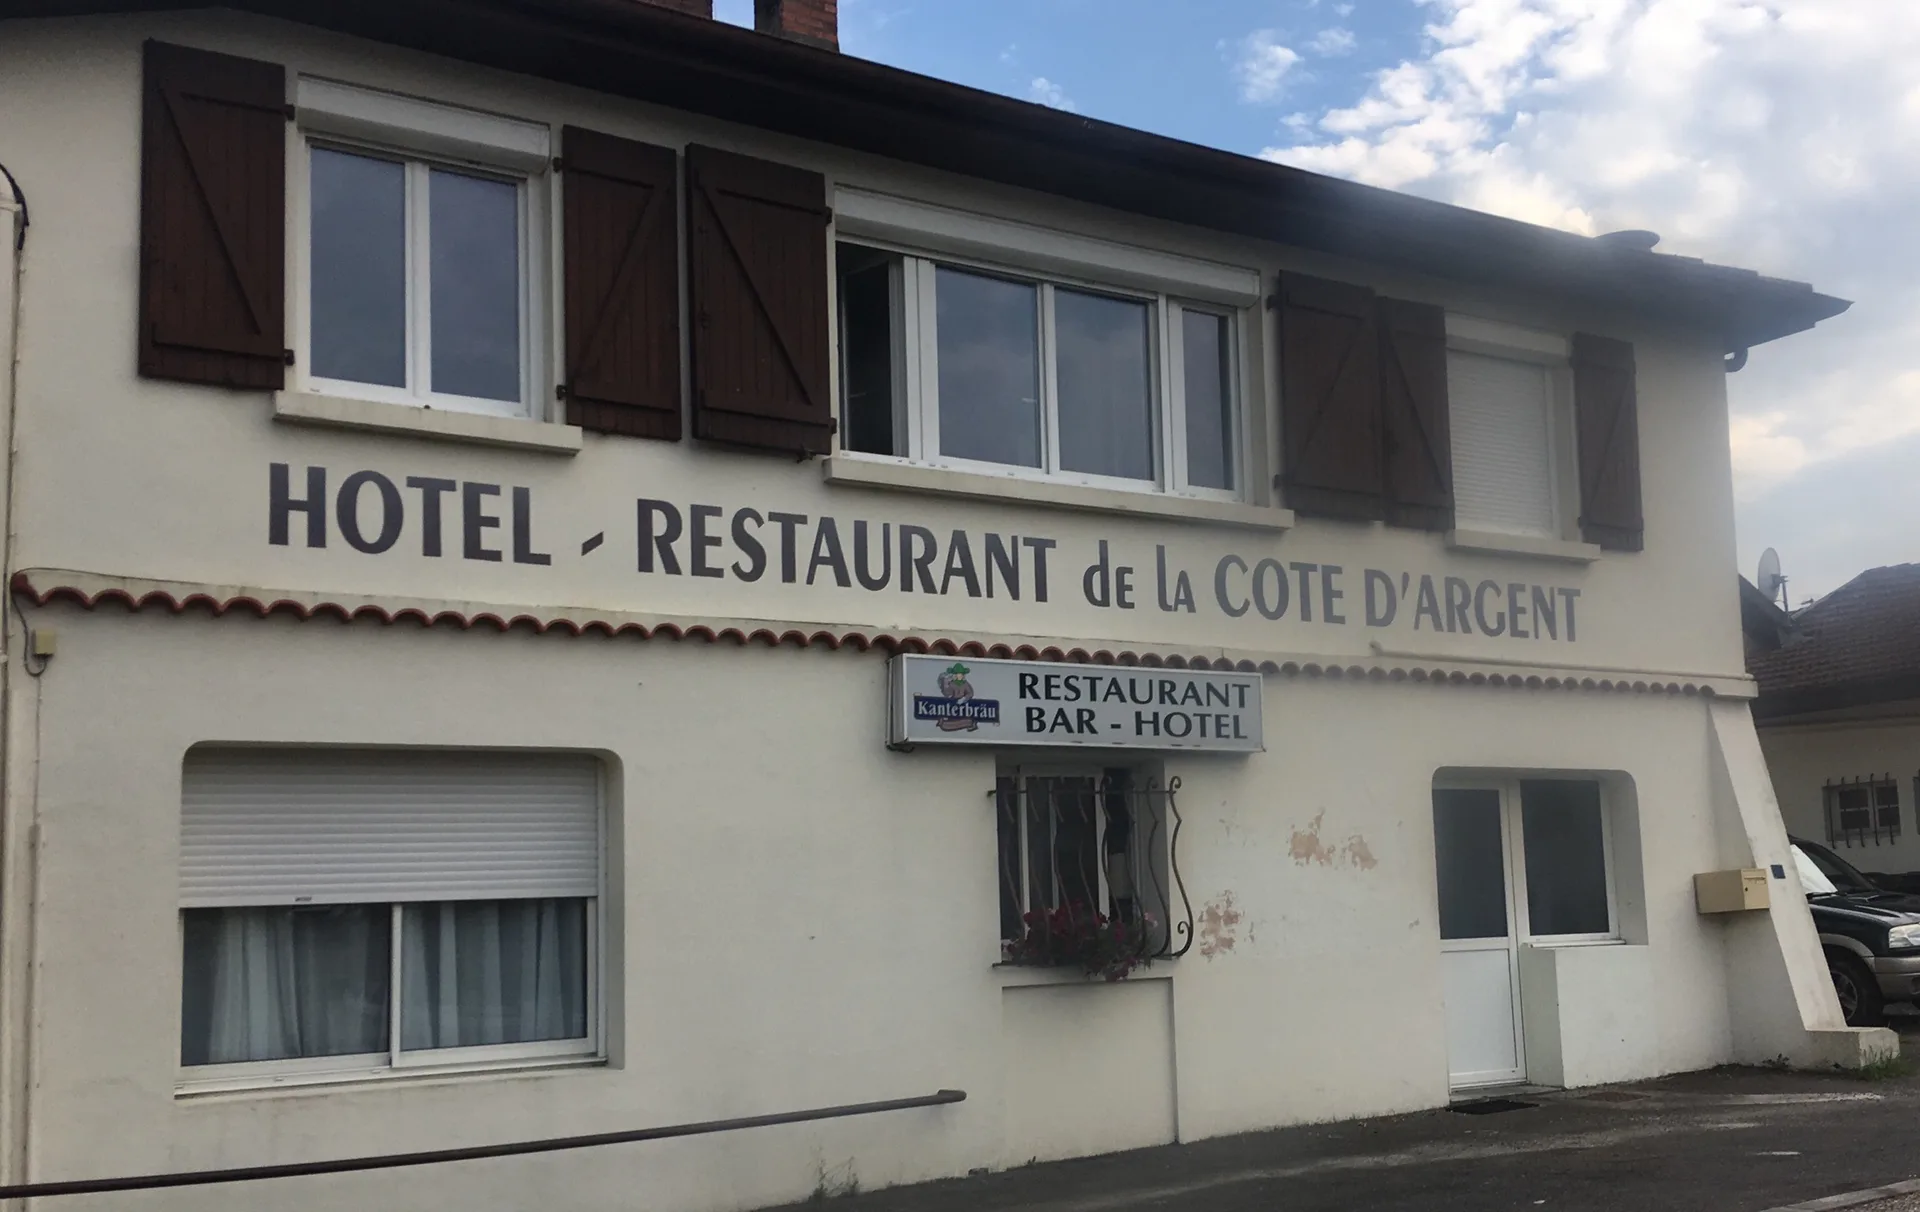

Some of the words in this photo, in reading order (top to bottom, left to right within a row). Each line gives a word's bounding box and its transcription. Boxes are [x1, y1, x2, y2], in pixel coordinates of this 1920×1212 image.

[269, 462, 551, 566] HOTEL
[636, 498, 1056, 603] RESTAURANT
[1213, 554, 1346, 625] COTE
[1364, 568, 1581, 642] D'ARGENT
[1018, 672, 1251, 708] RESTAURANT
[918, 700, 996, 718] Kanterbräu
[1025, 707, 1098, 735] BAR
[1134, 711, 1248, 739] HOTEL
